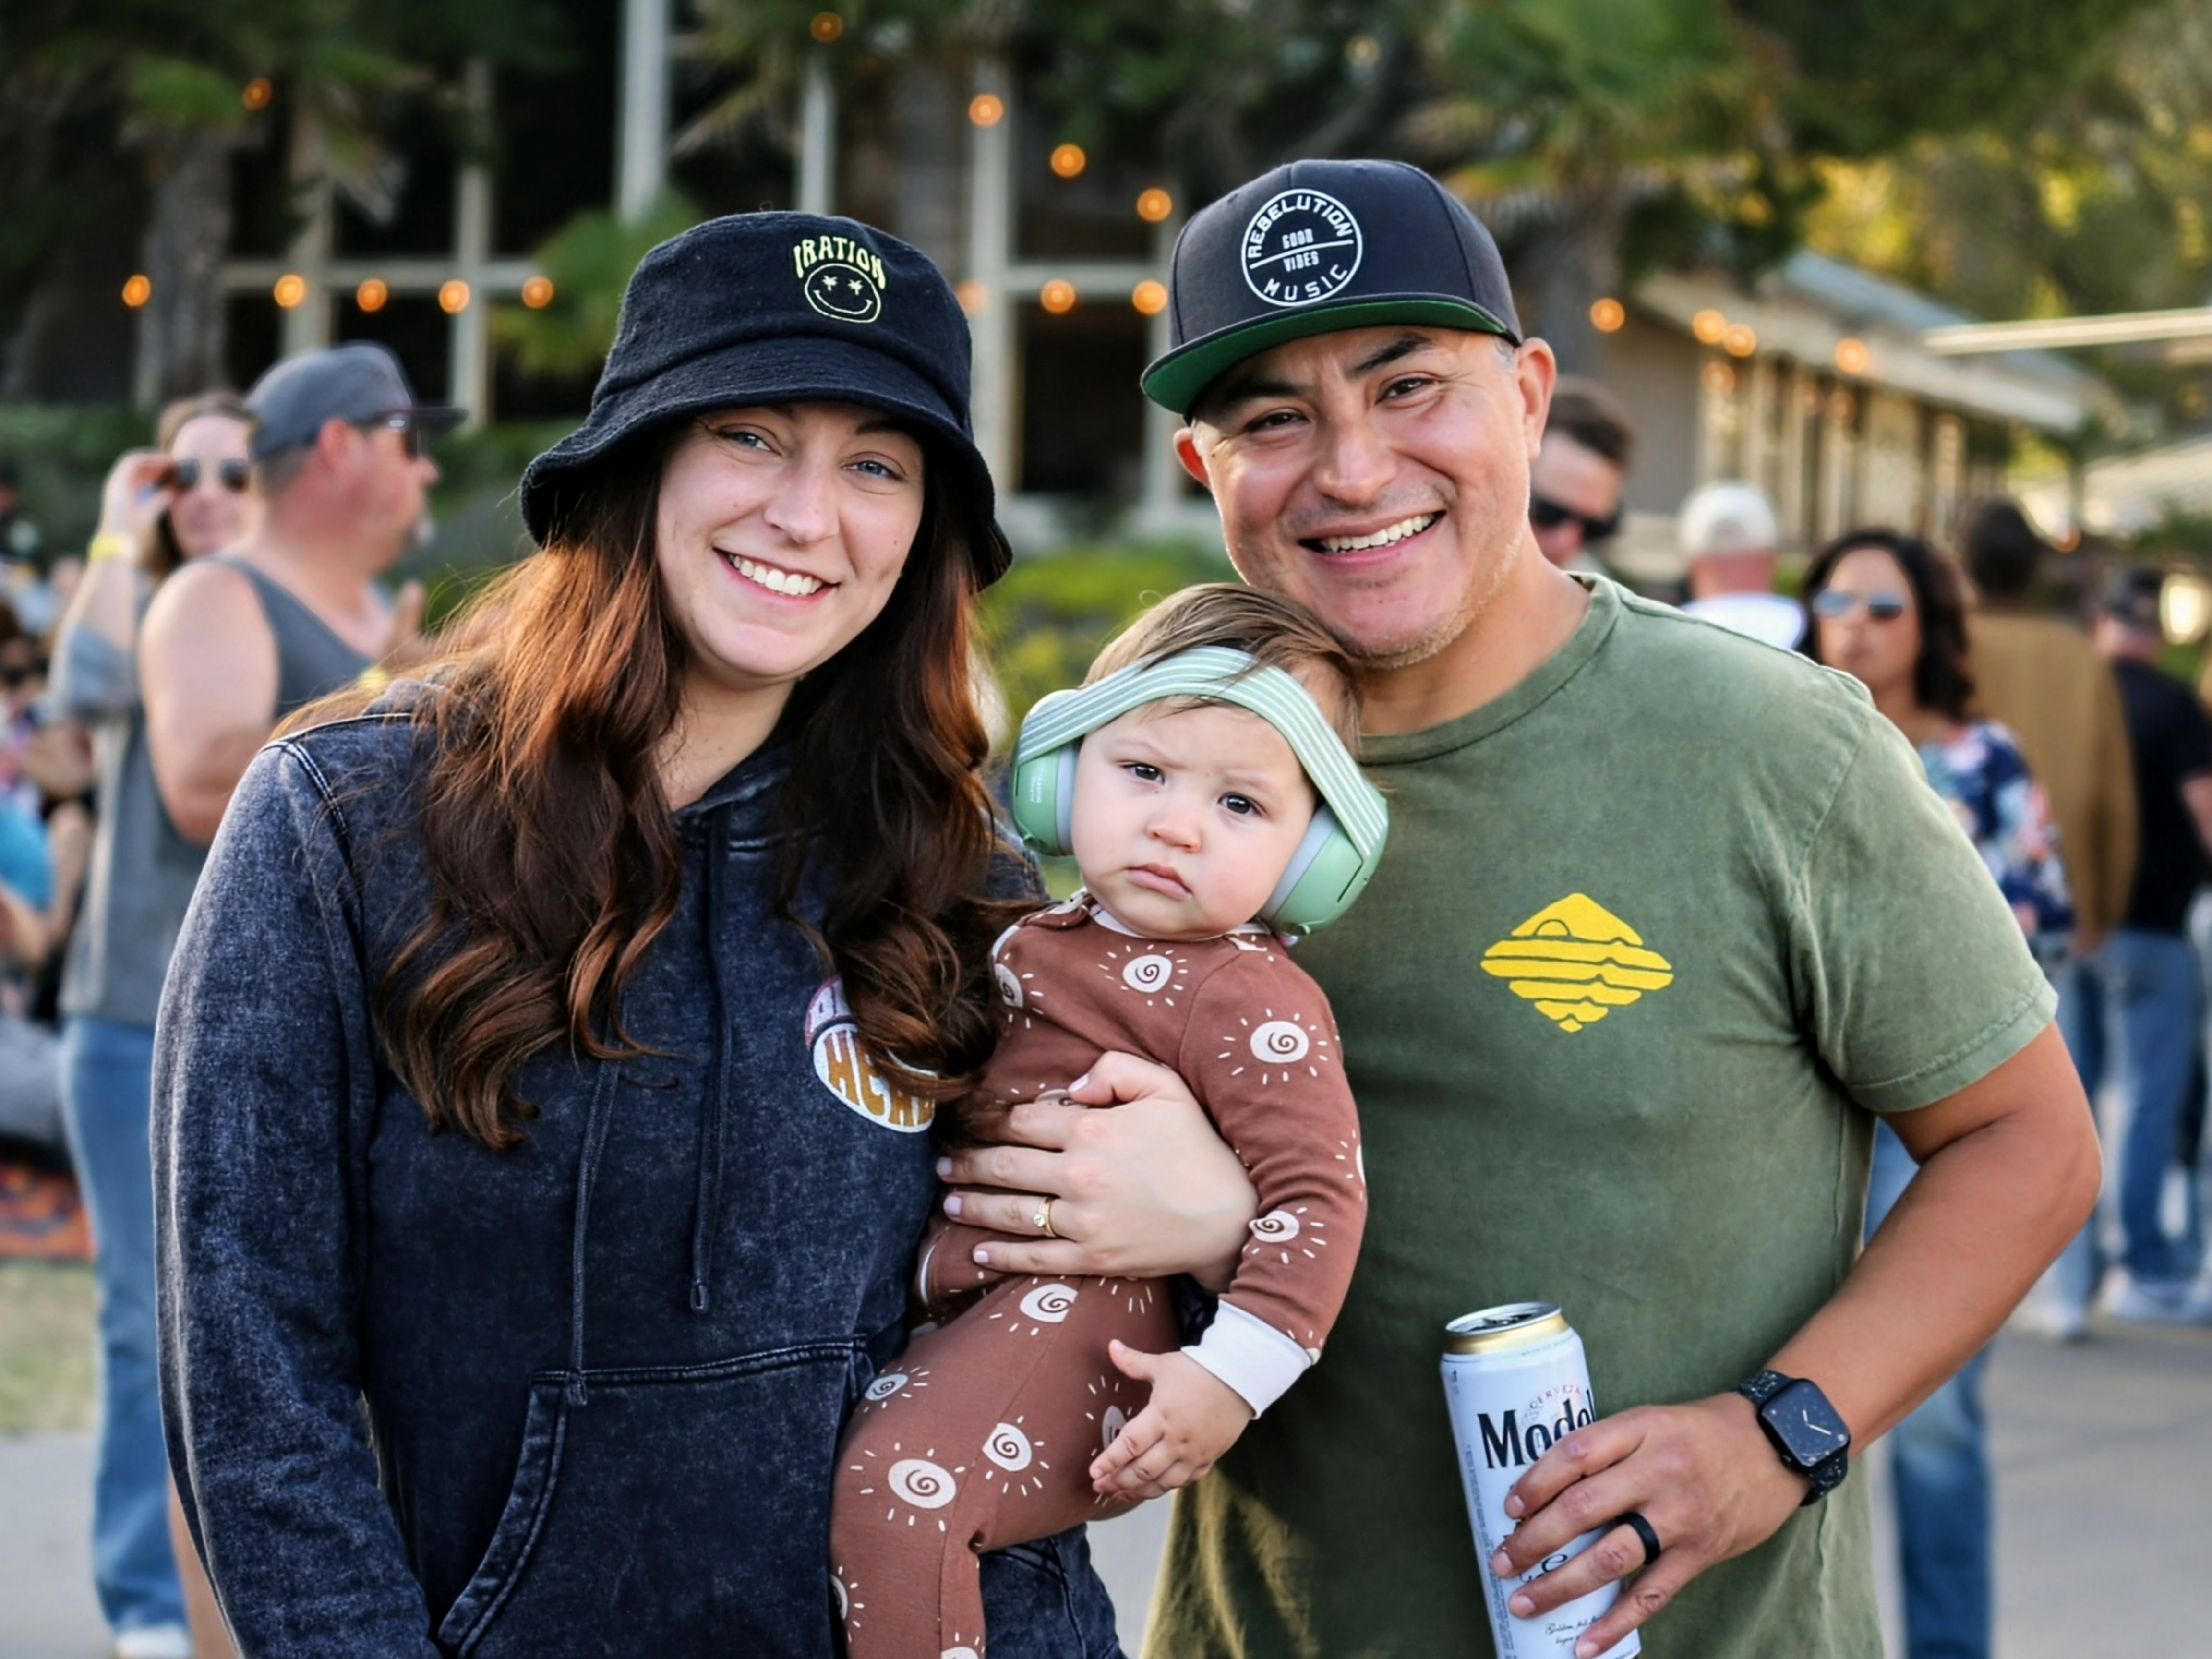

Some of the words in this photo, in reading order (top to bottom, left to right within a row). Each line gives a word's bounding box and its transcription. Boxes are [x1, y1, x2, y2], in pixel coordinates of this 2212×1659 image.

[1248, 195, 1353, 258] REBELUTION
[794, 236, 886, 289] IRATION
[1264, 264, 1347, 300] MUSIC
[1283, 251, 1319, 272] VIBES
